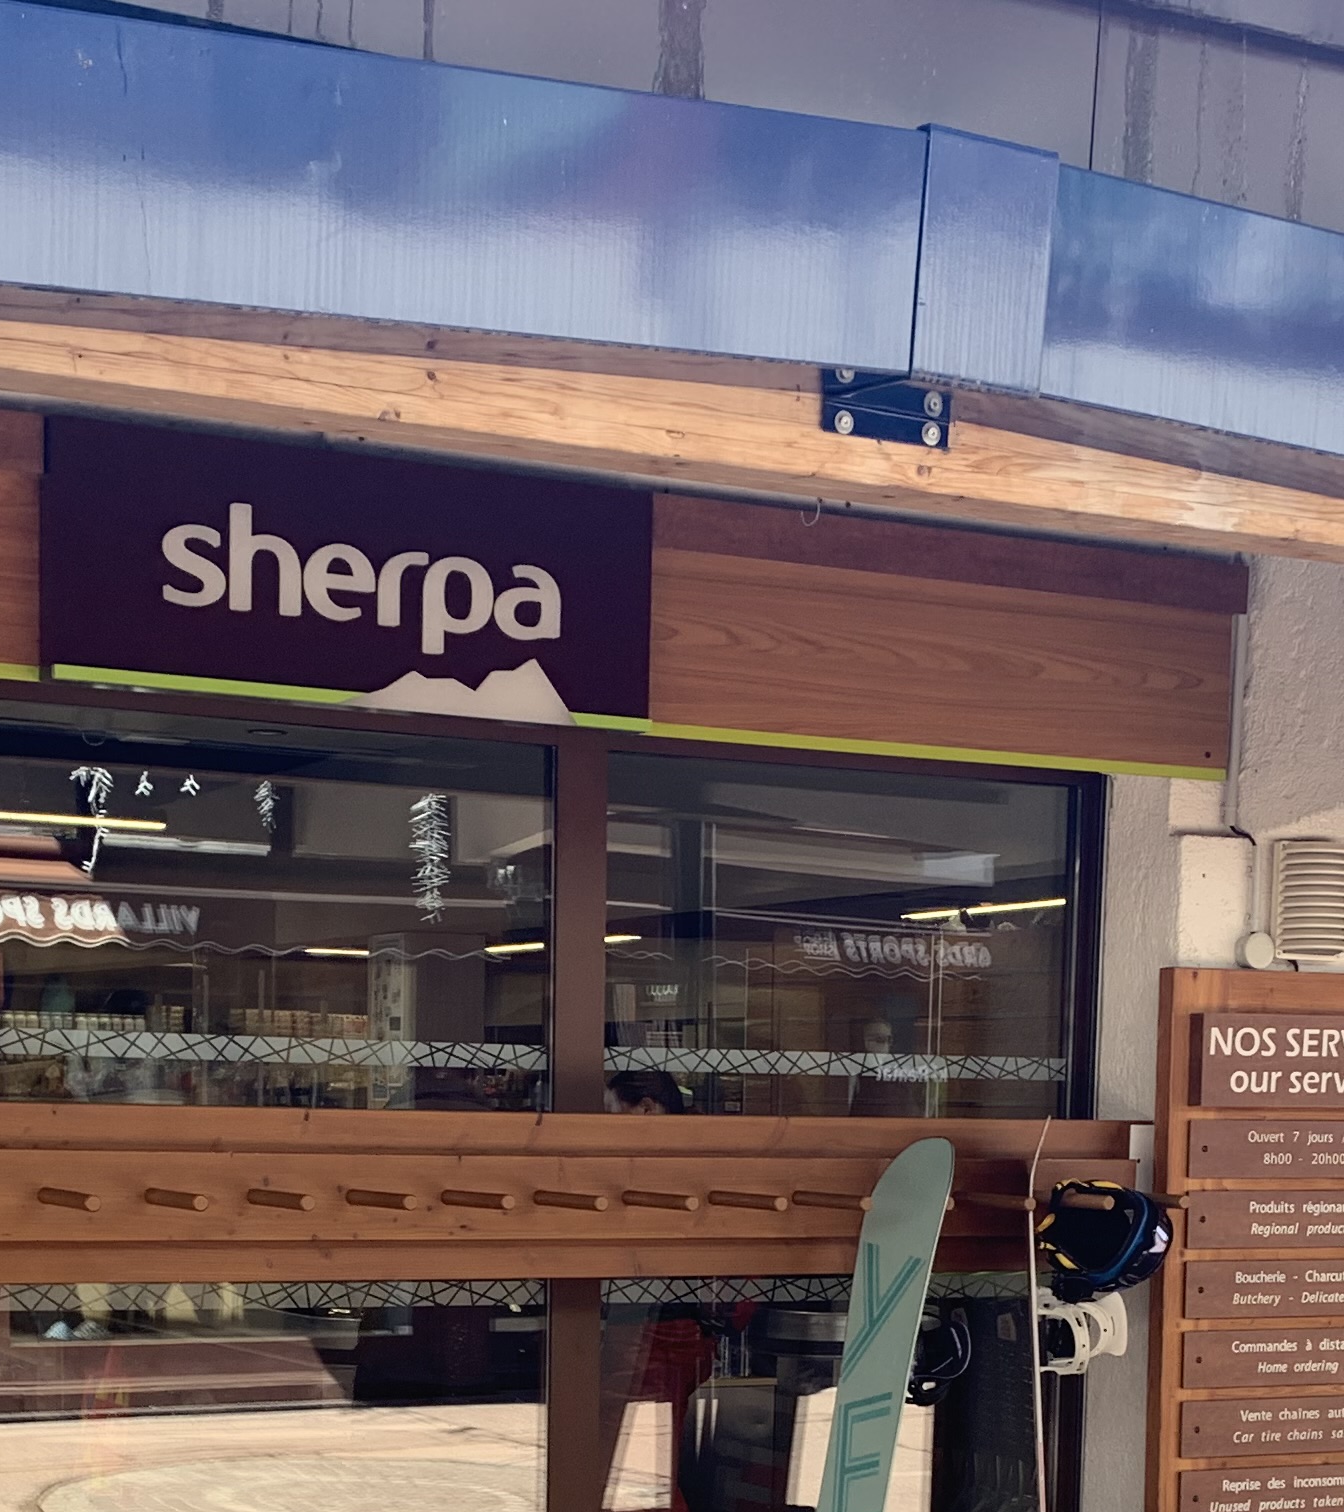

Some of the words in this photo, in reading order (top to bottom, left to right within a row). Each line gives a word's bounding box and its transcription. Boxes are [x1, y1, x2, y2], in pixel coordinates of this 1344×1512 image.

[161, 502, 562, 655] sherpa
[1209, 1027, 1277, 1057] NOS
[1230, 1070, 1282, 1093] our
[1247, 1130, 1285, 1143] Ouvert
[1292, 1130, 1300, 1142] 7
[1307, 1131, 1334, 1146] jours
[1263, 1152, 1293, 1165] 8h00
[1249, 1201, 1295, 1214] Produits
[1250, 1222, 1300, 1237] Regional
[1235, 1270, 1287, 1284] Boucherie
[1232, 1292, 1281, 1307] Butchery
[1231, 1339, 1298, 1354] Commandes
[1305, 1338, 1313, 1351] à
[1257, 1361, 1288, 1373] Home
[1293, 1360, 1340, 1374] ordering
[1240, 1409, 1273, 1422] Vente
[1278, 1408, 1321, 1421] chaînes
[1232, 1431, 1255, 1443] Car
[1260, 1429, 1282, 1442] tire
[1286, 1428, 1324, 1441] chains
[1222, 1479, 1262, 1494] Reprise
[1266, 1477, 1286, 1490] des
[1209, 1499, 1252, 1512] Unused
[1258, 1498, 1306, 1512] products
[1312, 1495, 1344, 1508] taken
